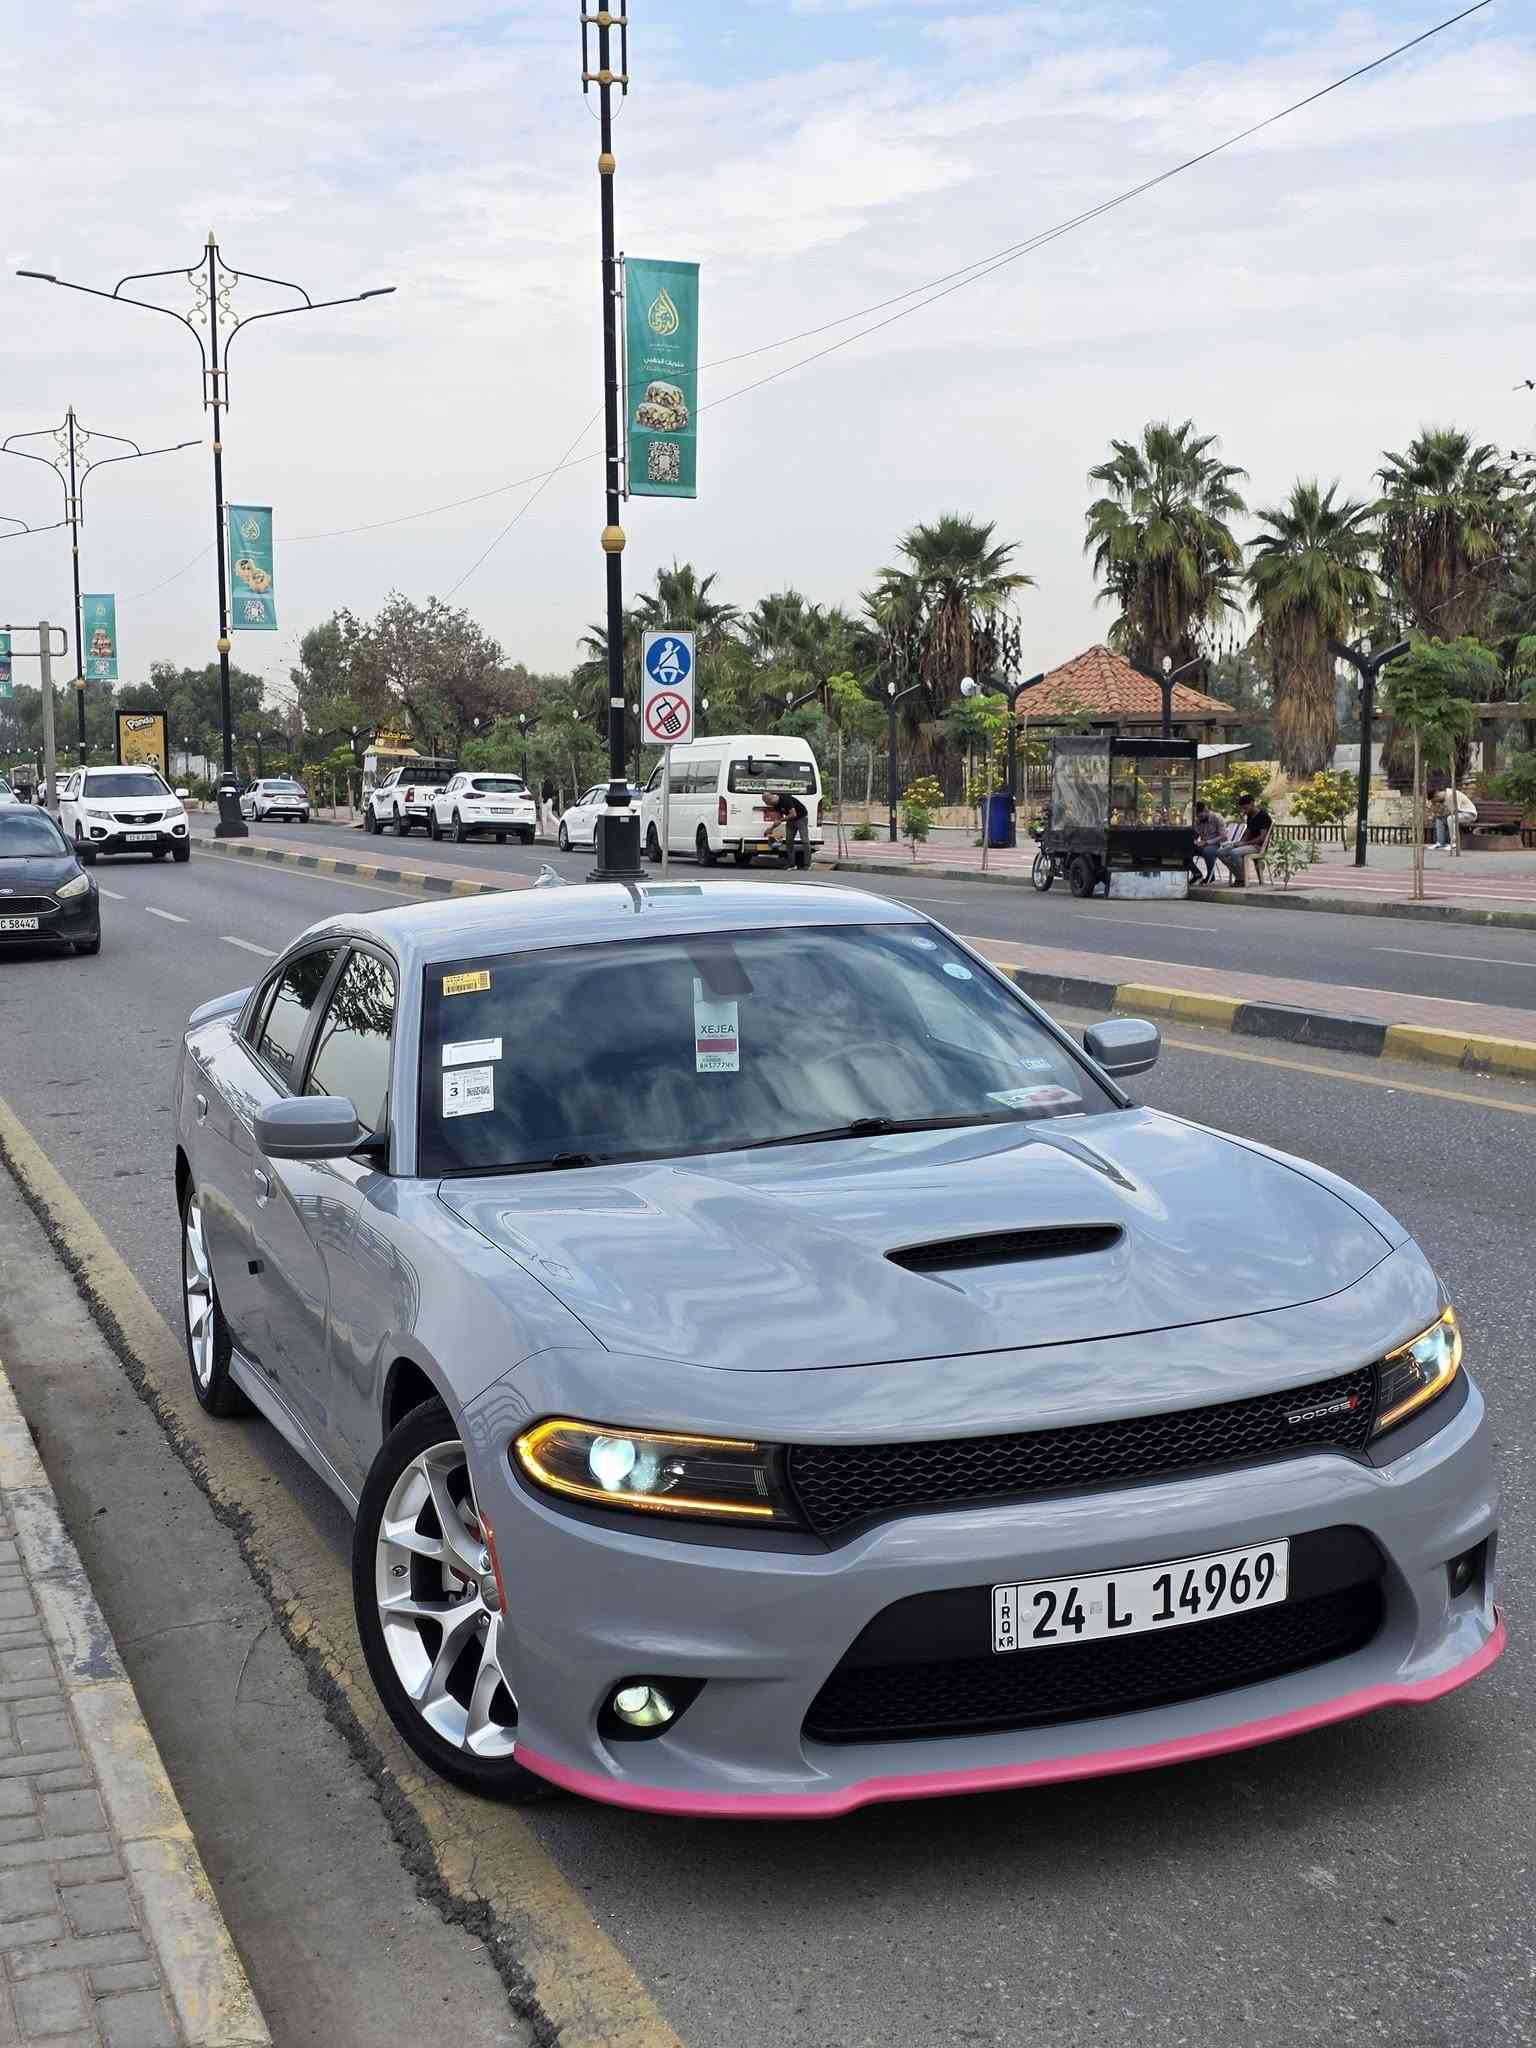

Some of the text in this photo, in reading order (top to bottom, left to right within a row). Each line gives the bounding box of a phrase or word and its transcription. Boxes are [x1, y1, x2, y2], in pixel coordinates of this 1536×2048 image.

[126, 717, 154, 730] Panda
[9, 918, 36, 929] 58442
[700, 1024, 735, 1034] XEJEA
[449, 1087, 459, 1097] 3
[1287, 1401, 1352, 1424] DODGE
[1033, 1552, 1275, 1639] 24 L 14969
[999, 1636, 1014, 1649] KR
